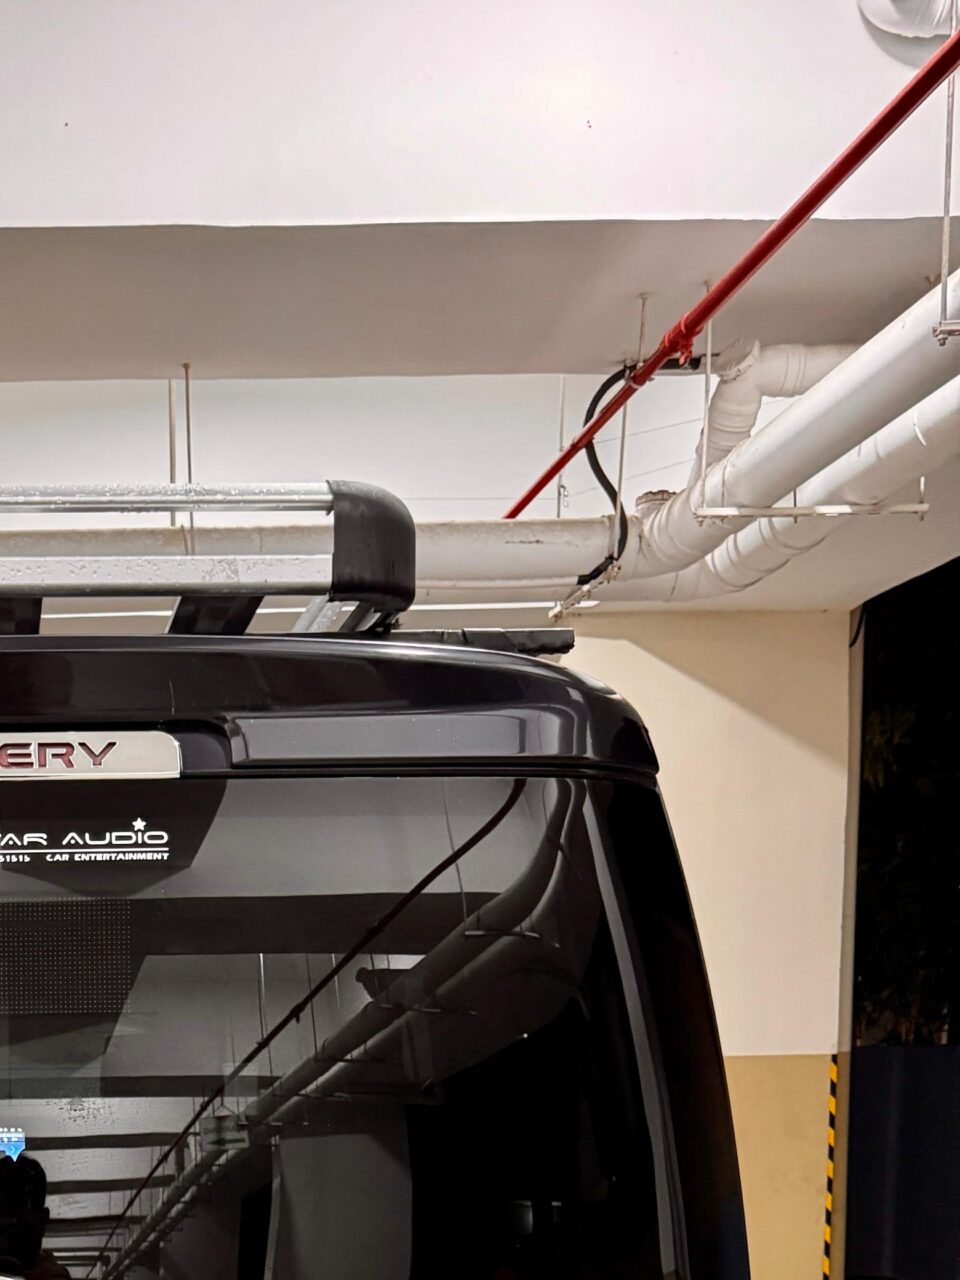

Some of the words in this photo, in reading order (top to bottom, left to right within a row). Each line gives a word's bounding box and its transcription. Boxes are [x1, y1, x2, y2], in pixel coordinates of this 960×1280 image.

[62, 826, 169, 846] AUDIO
[46, 853, 69, 862] CAR
[74, 852, 170, 862] ENTERTAINMENT
